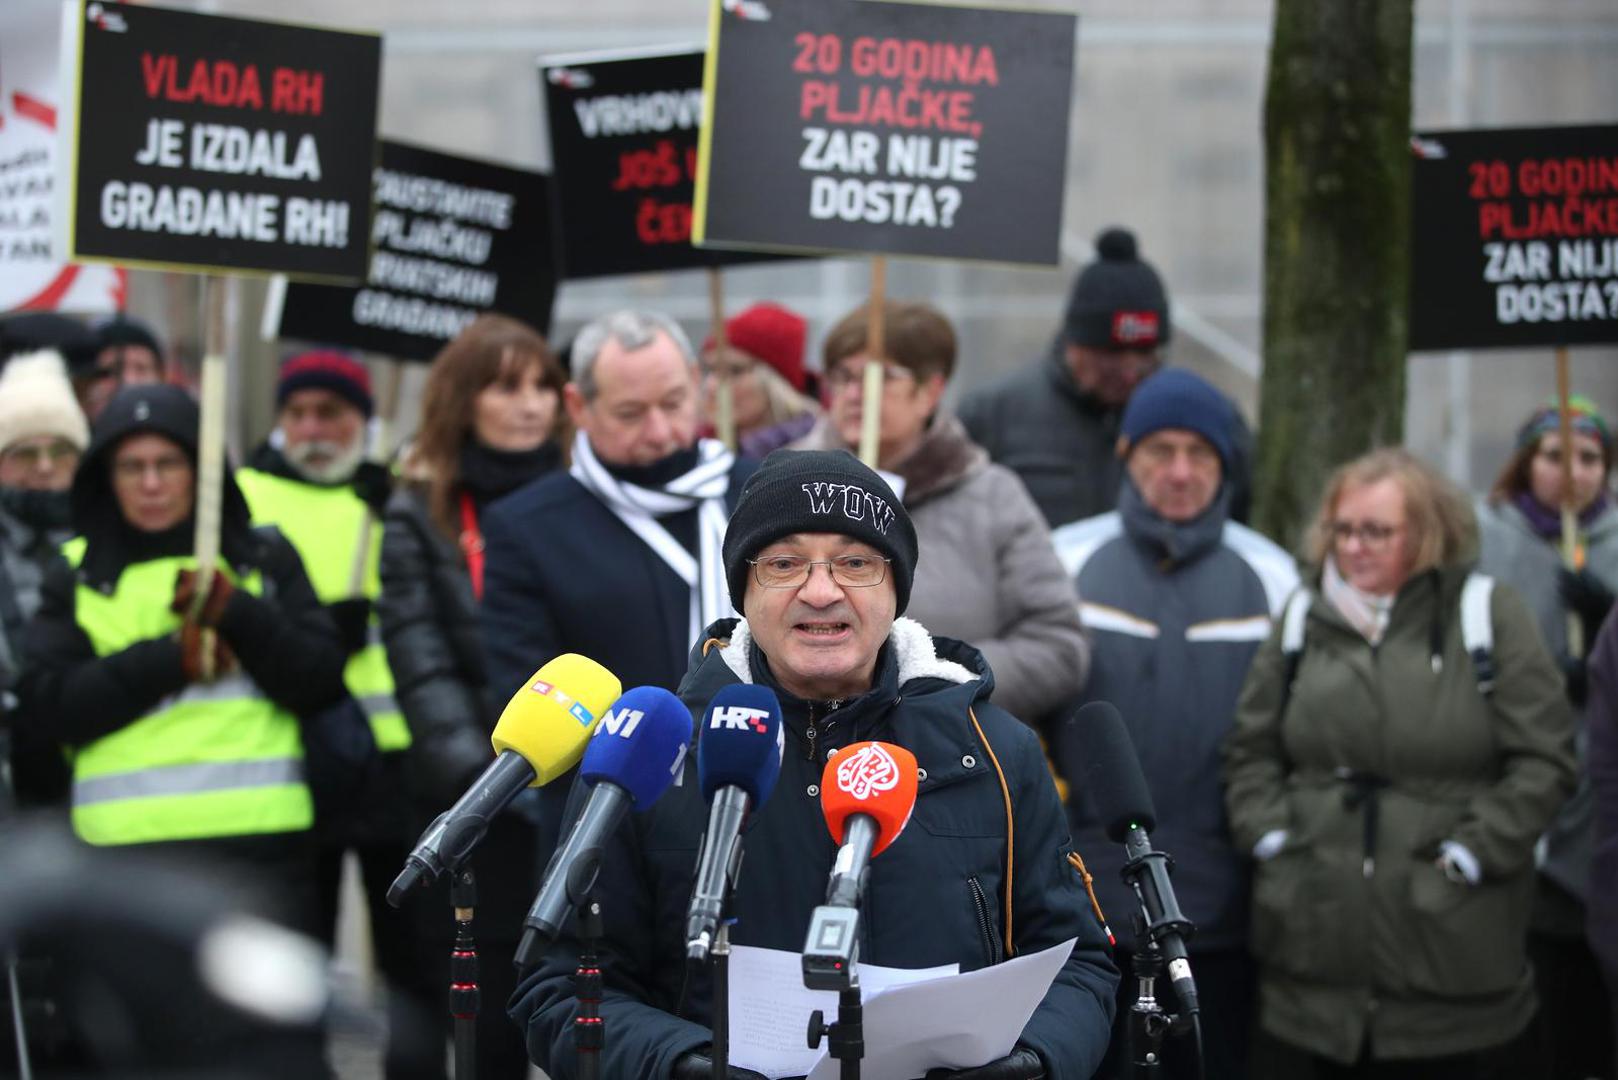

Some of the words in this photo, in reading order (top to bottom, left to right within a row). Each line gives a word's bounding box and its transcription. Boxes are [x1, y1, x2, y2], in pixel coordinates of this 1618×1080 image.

[141, 51, 263, 110] VLADA
[270, 66, 325, 116] RH
[793, 31, 843, 75] 20
[851, 38, 998, 85] GODINA
[800, 80, 984, 138] PLJAČKE,
[136, 119, 183, 167] JE
[190, 122, 322, 182] IZDALA
[800, 127, 881, 176] ZAR
[887, 135, 979, 182] NIJE
[809, 176, 963, 230] DOSTA?
[1469, 161, 1510, 198] 20
[100, 180, 280, 243] GRAĐANE
[284, 197, 350, 248] RH!
[1484, 241, 1550, 282] ZAR
[801, 482, 896, 535] WOW
[532, 680, 594, 727] RTL
[593, 708, 645, 739] N1
[710, 706, 770, 734] HRT
